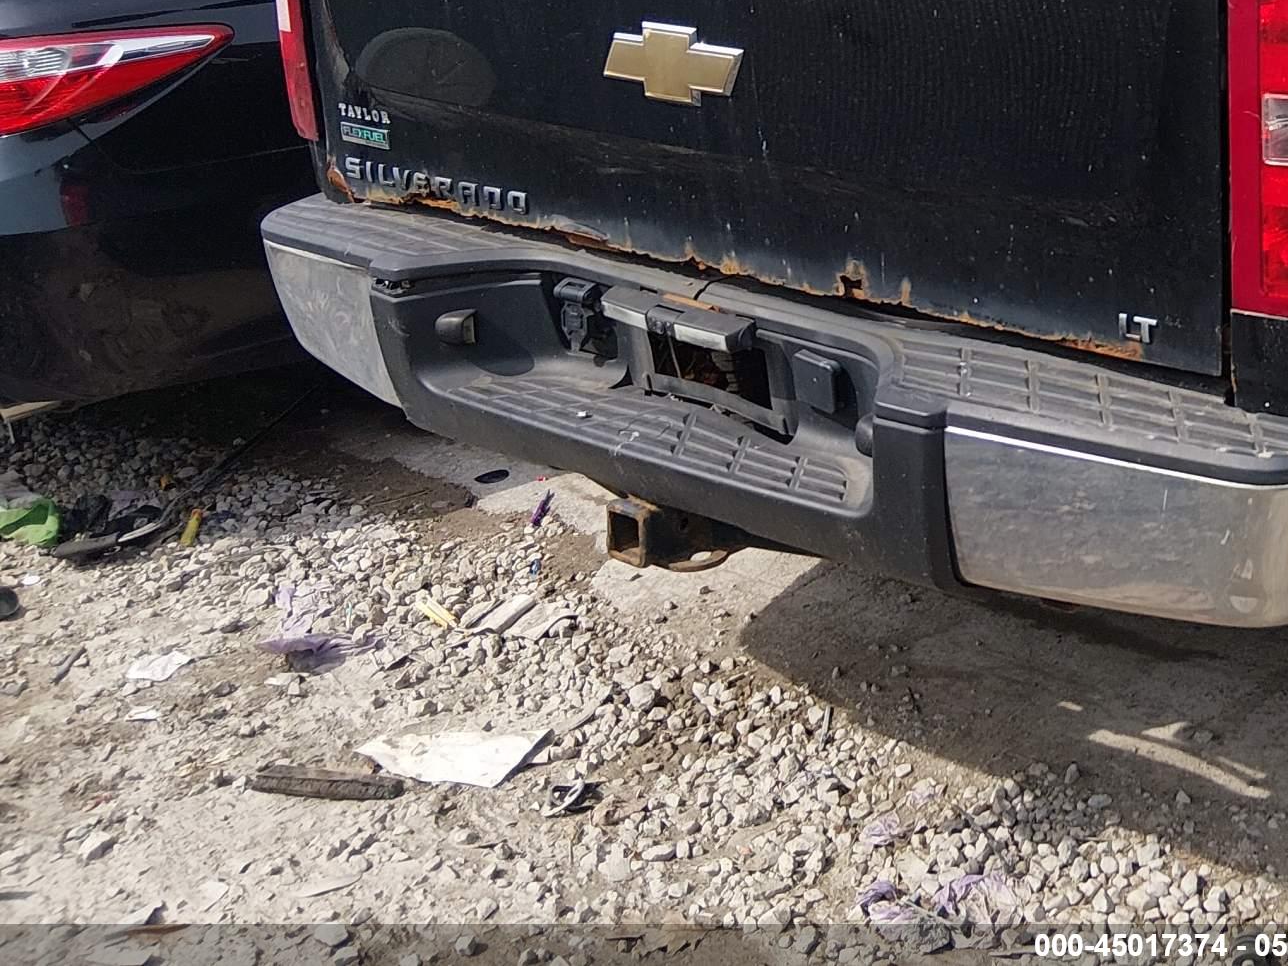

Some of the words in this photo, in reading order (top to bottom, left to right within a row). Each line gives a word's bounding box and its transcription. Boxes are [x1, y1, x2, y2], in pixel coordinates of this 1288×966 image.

[338, 102, 391, 125] TAYLOR
[344, 155, 528, 215] SILVERADO
[1118, 312, 1158, 344] LT
